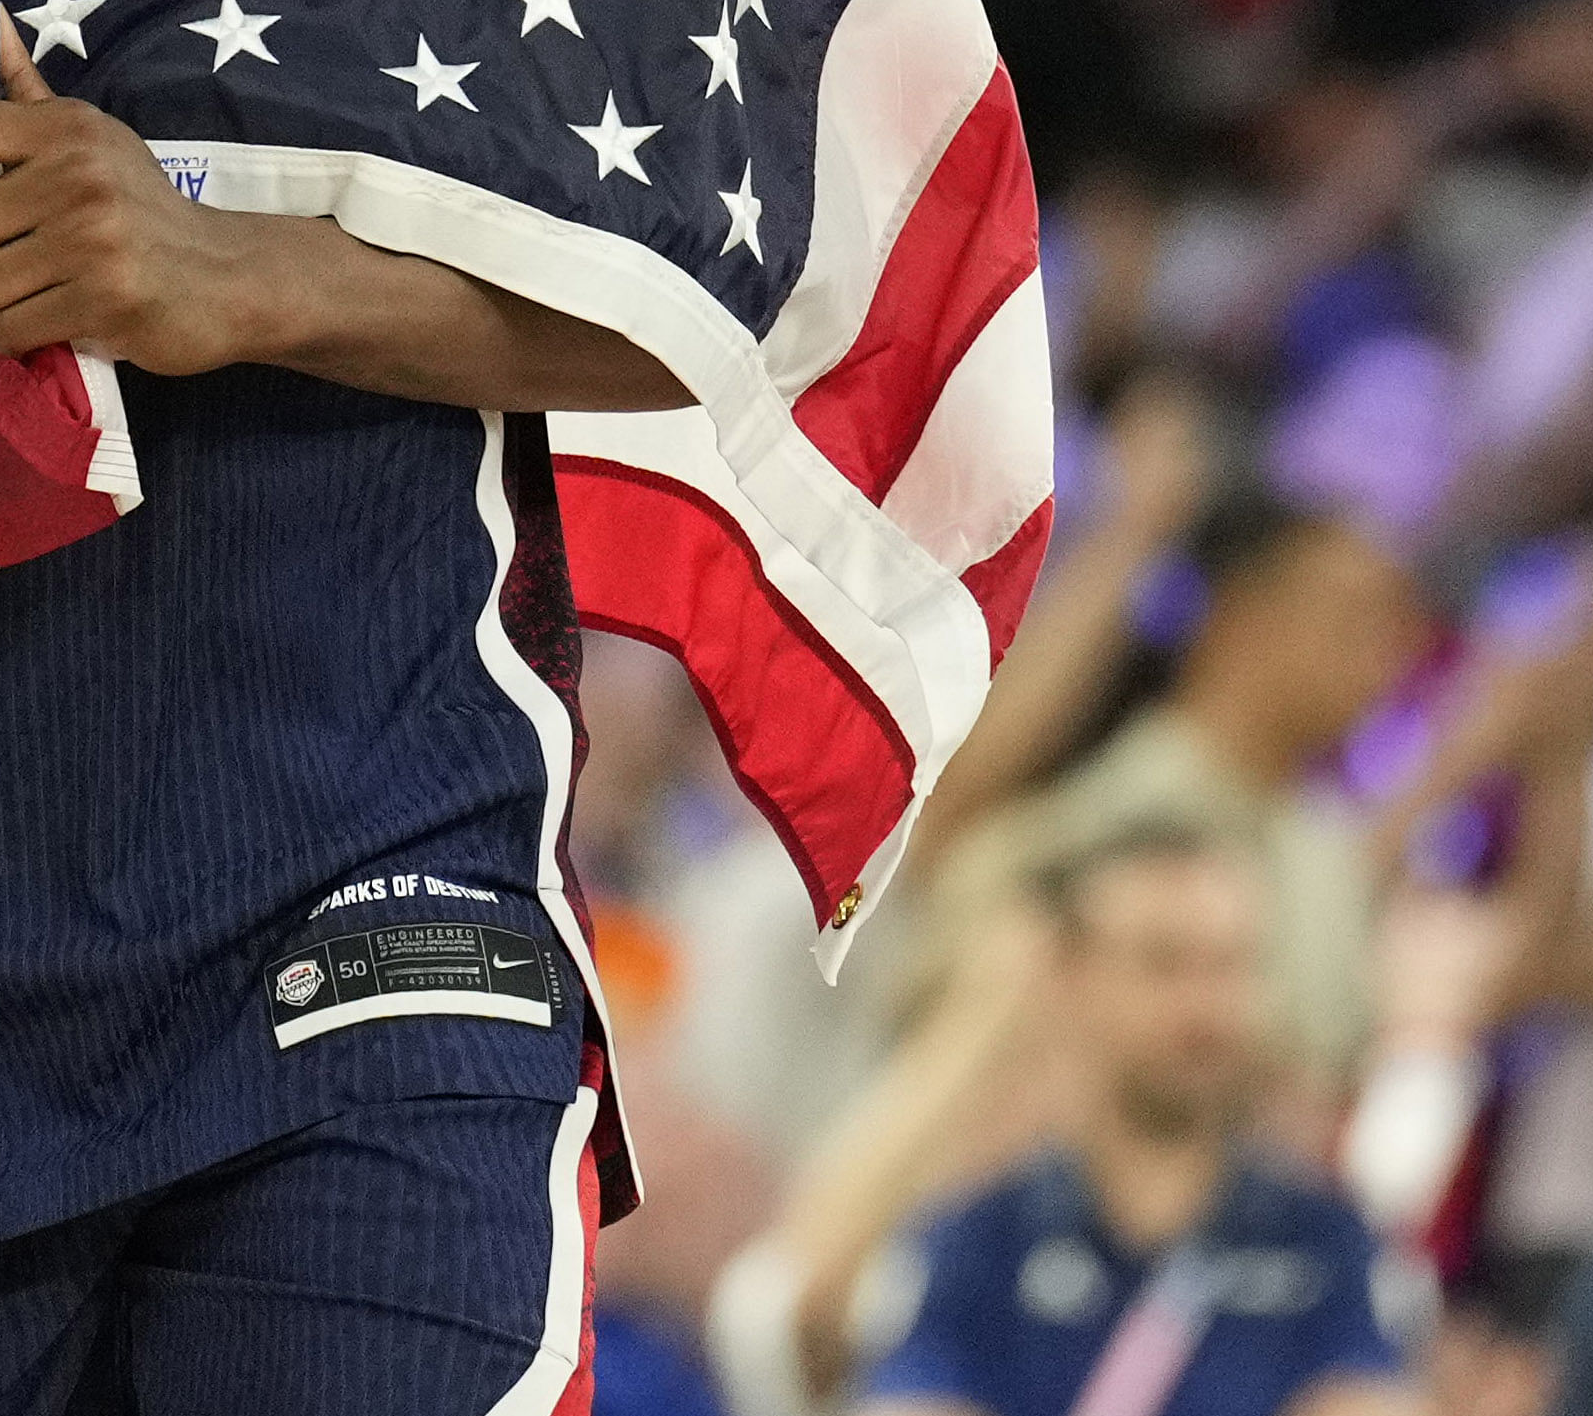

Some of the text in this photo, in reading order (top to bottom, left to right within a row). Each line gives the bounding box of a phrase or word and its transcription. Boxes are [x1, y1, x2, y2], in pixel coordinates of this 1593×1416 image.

[308, 874, 499, 920] SPARKS OF DESTINY
[376, 928, 475, 945] ENGINEERED
[339, 960, 367, 979] 50
